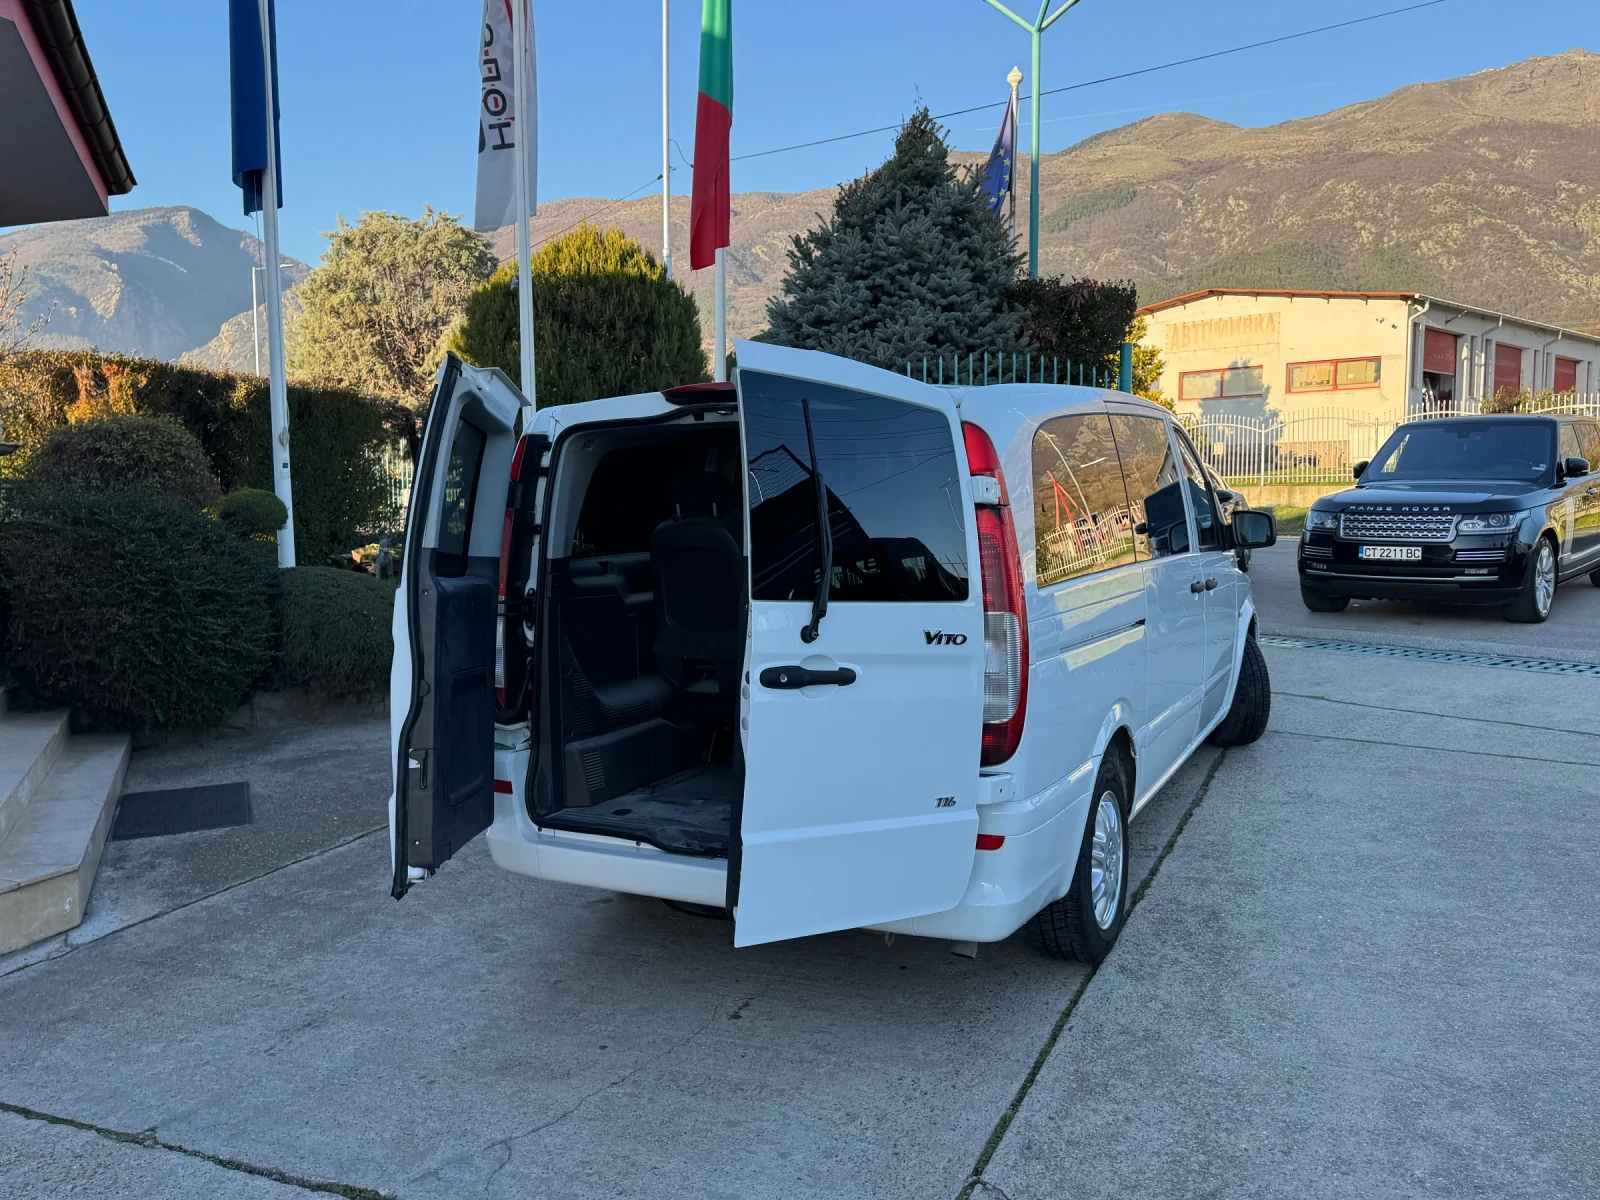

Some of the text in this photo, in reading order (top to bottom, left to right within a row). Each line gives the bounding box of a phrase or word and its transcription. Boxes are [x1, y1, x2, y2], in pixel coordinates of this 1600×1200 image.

[1170, 314, 1276, 351] АВТОМИВКА
[1364, 547, 1421, 559] CT 2211 BC
[934, 796, 957, 808] 116
